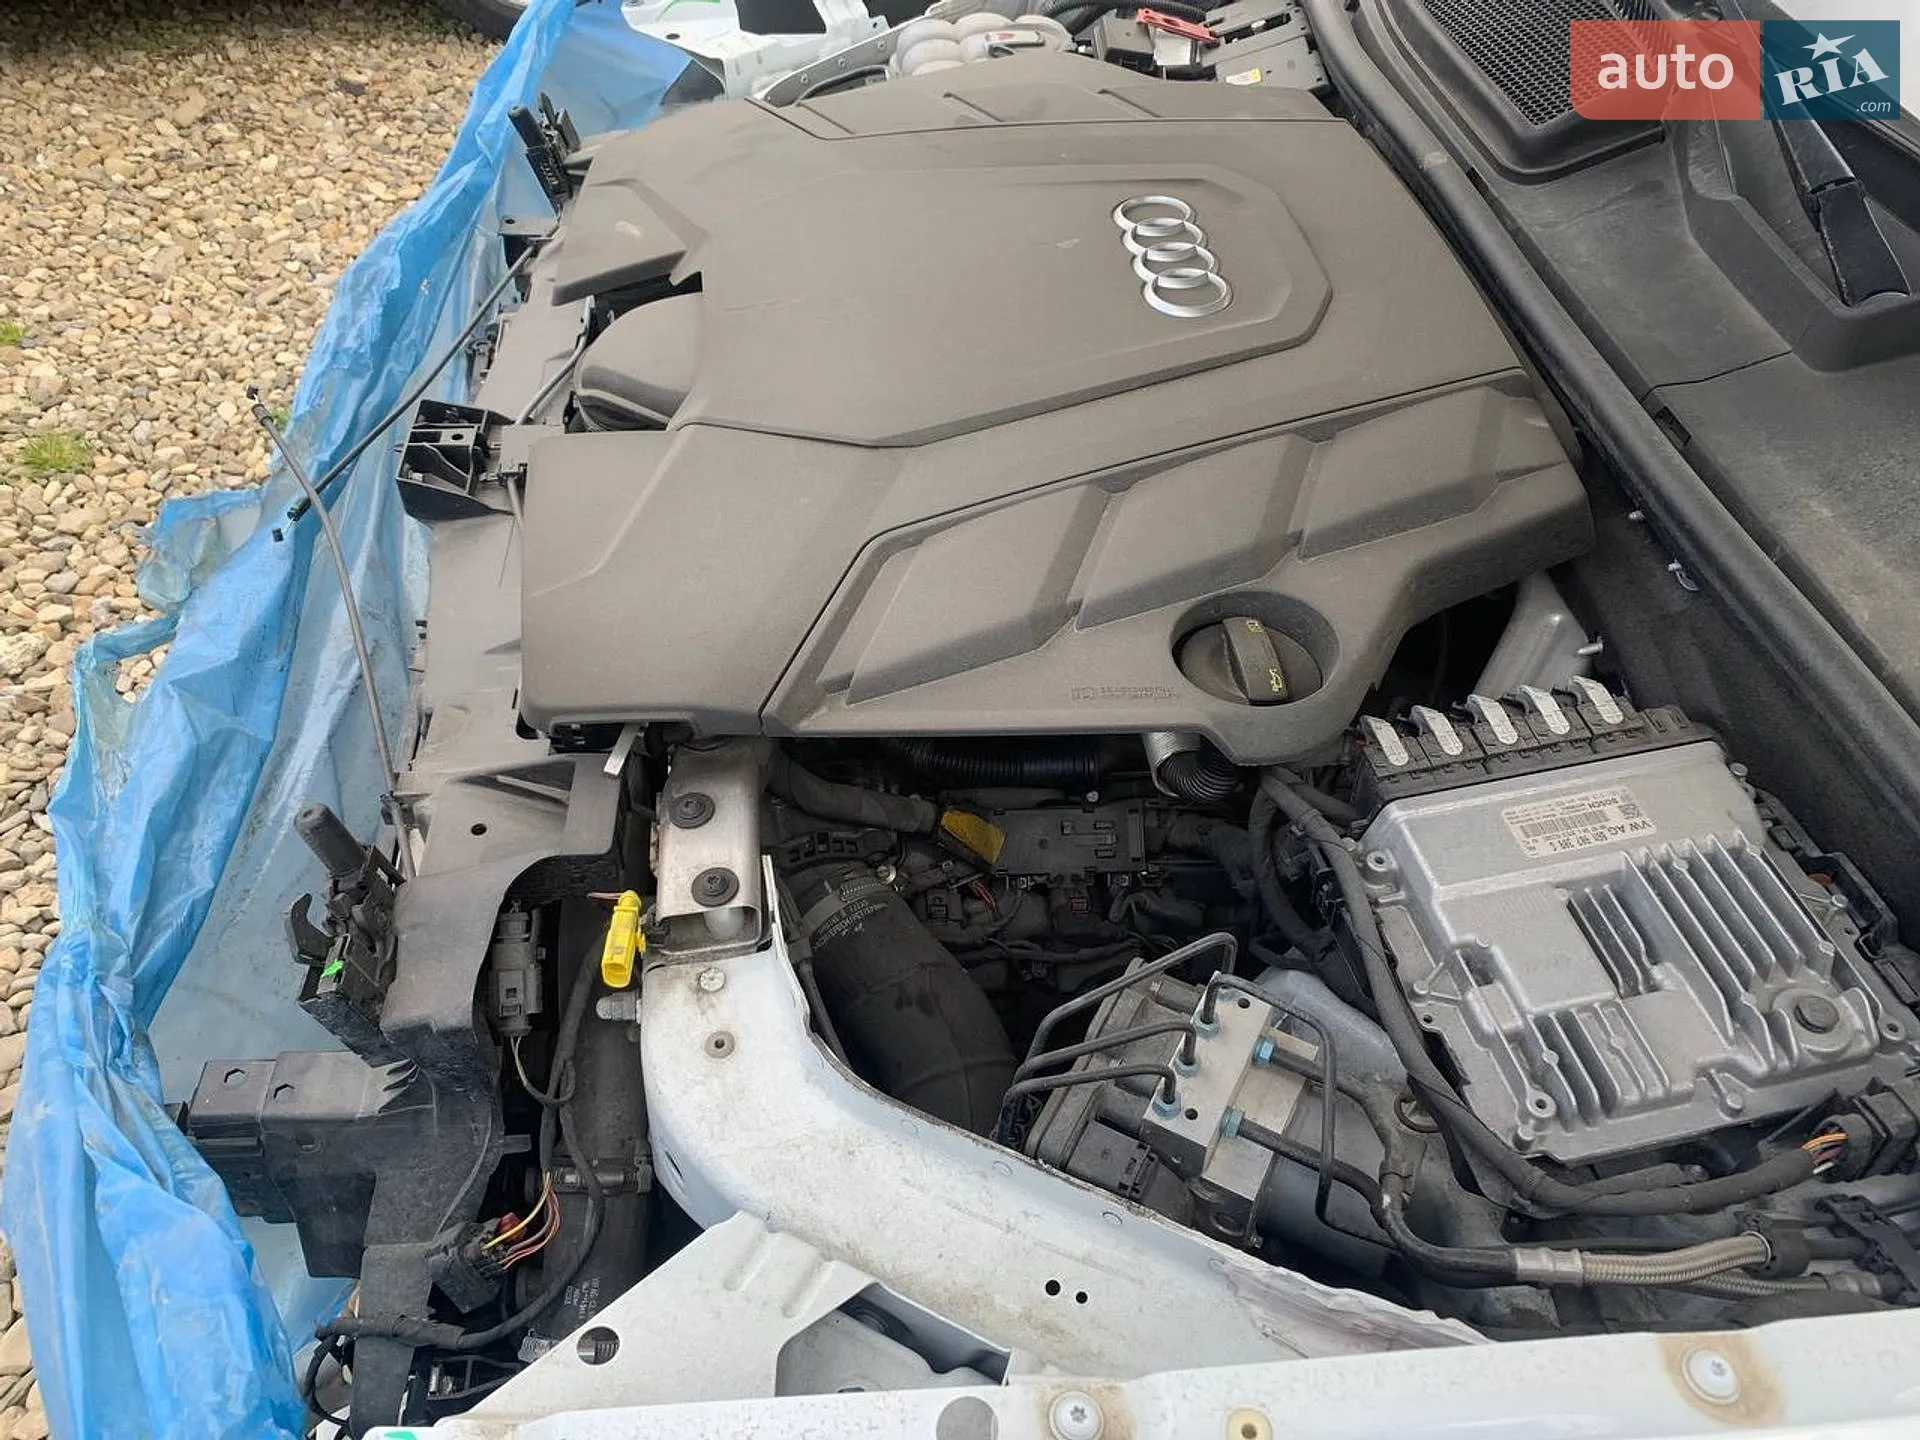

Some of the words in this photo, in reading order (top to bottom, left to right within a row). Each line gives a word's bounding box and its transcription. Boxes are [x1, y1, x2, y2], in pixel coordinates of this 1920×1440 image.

[1587, 798, 1619, 810] BOSCH
[1607, 824, 1626, 836] AG
[1629, 820, 1652, 832] VW
